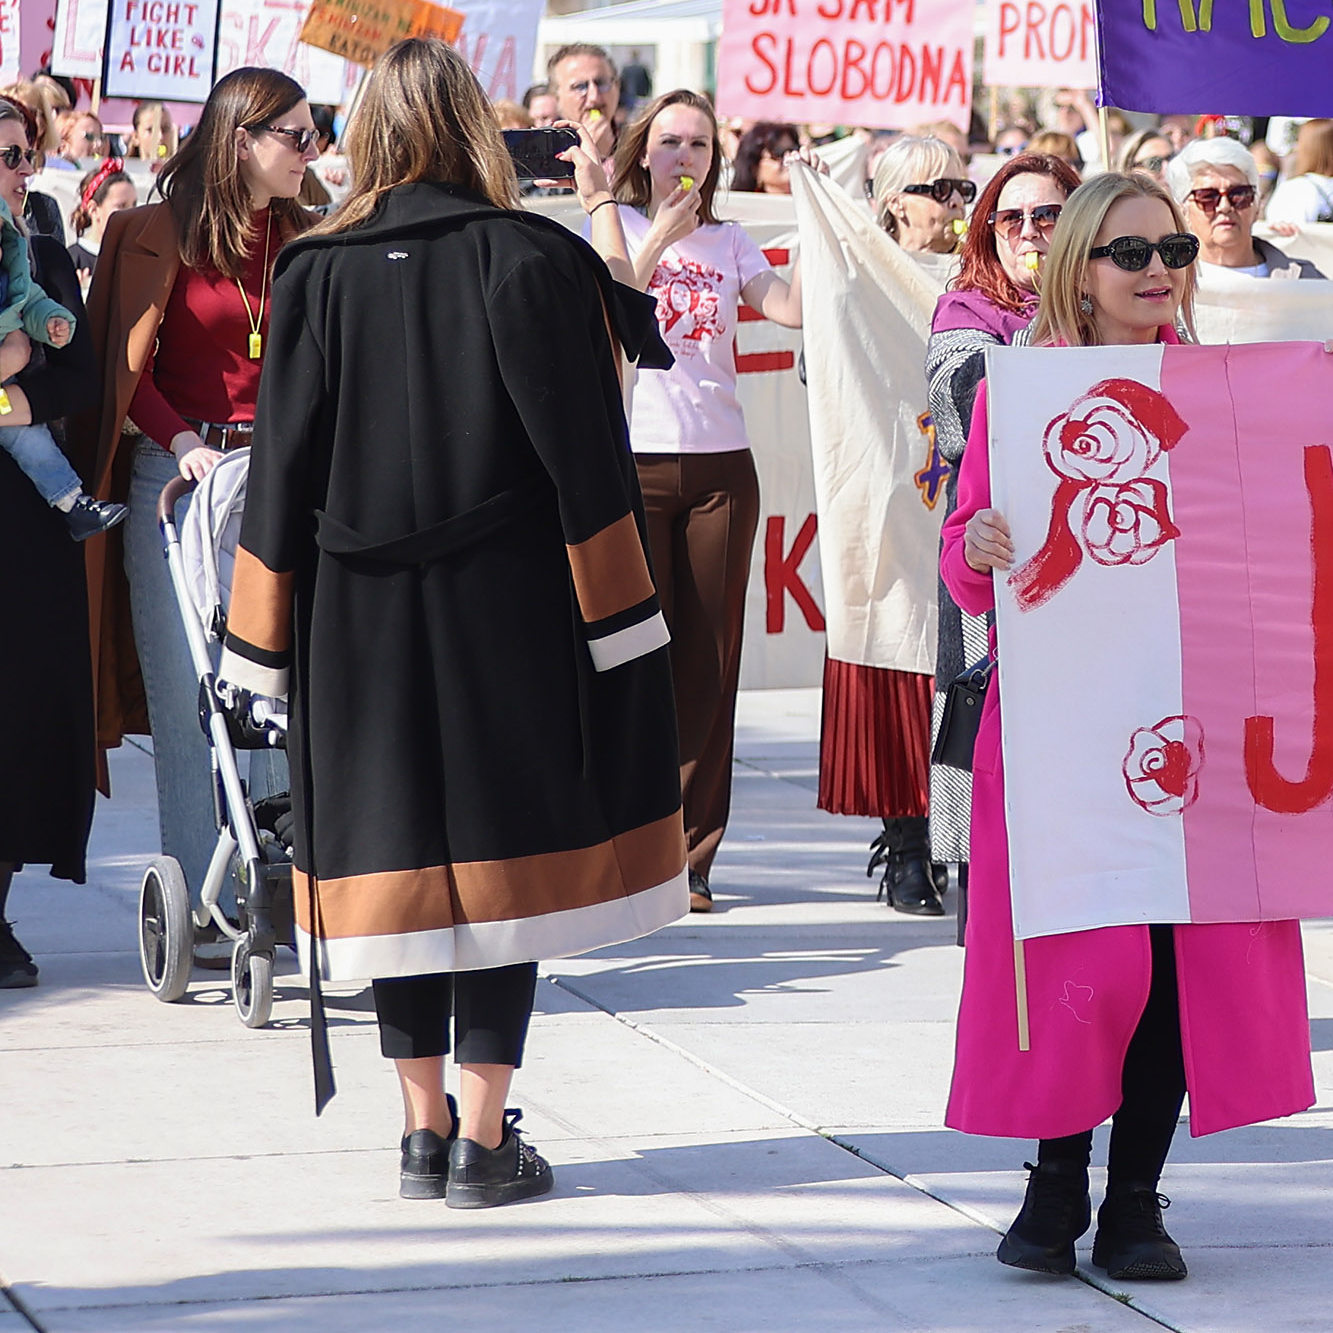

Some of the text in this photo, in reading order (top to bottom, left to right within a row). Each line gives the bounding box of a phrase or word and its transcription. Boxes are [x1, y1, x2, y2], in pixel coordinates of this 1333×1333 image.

[125, 0, 200, 27] FIGHT
[129, 26, 185, 51] LIKE
[119, 50, 200, 79] A GIRL
[744, 32, 967, 105] SLOBODNA
